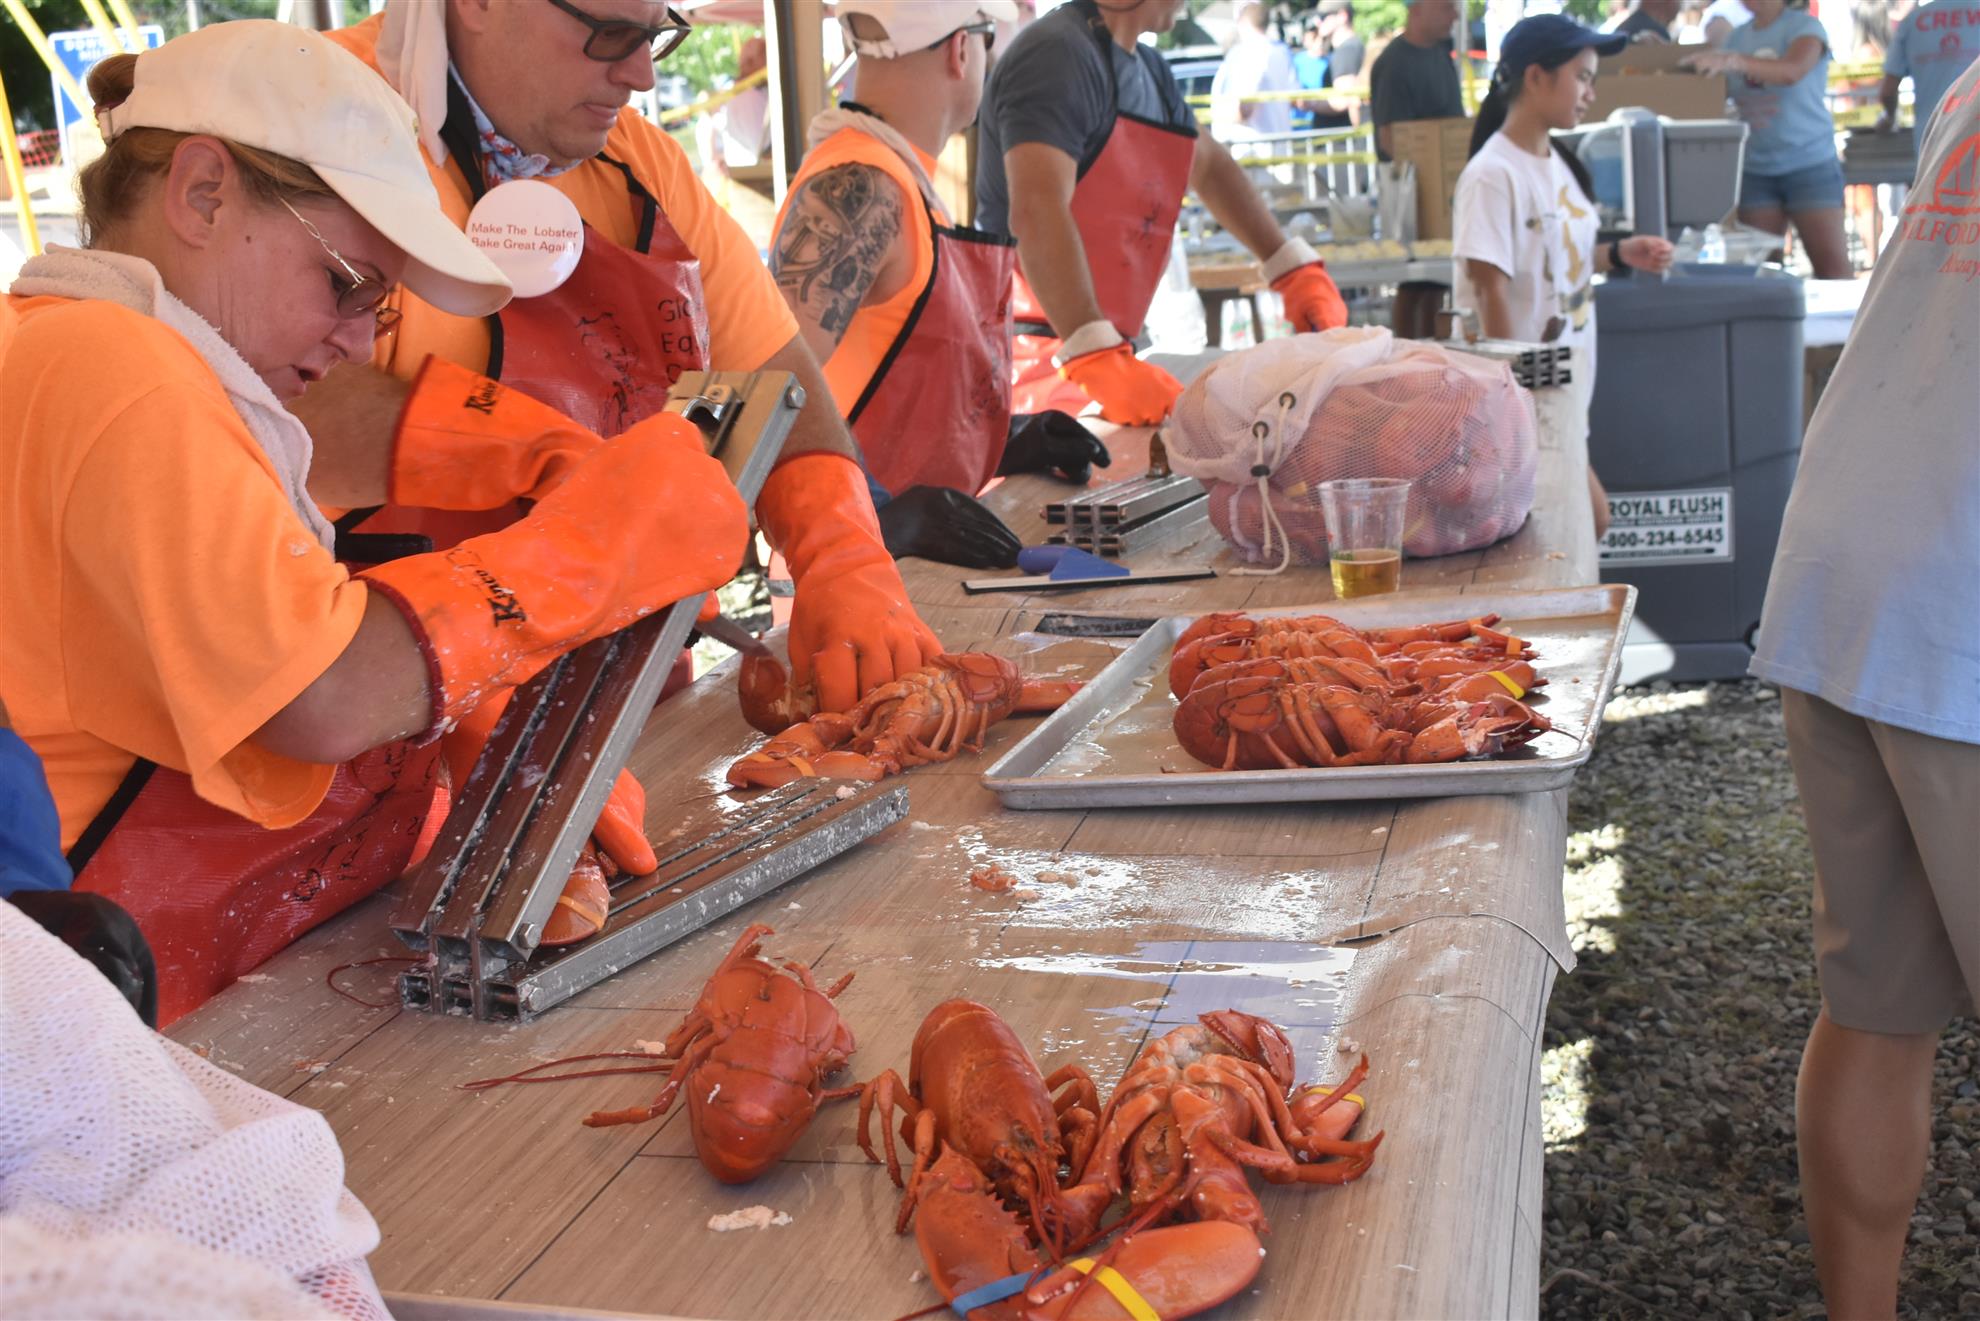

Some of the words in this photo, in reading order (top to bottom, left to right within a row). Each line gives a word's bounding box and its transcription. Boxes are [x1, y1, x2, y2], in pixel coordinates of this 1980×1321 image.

[471, 222, 502, 234] Make
[507, 224, 527, 235] The
[534, 226, 578, 238] Lobster
[471, 237, 500, 249] Bake
[503, 238, 536, 250] Great
[539, 241, 576, 254] Agai!
[1608, 500, 1662, 517] ROYAL
[1669, 496, 1723, 513] FLUSH
[1601, 527, 1723, 548] -800-234-6545
[475, 569, 527, 628] Kinco
